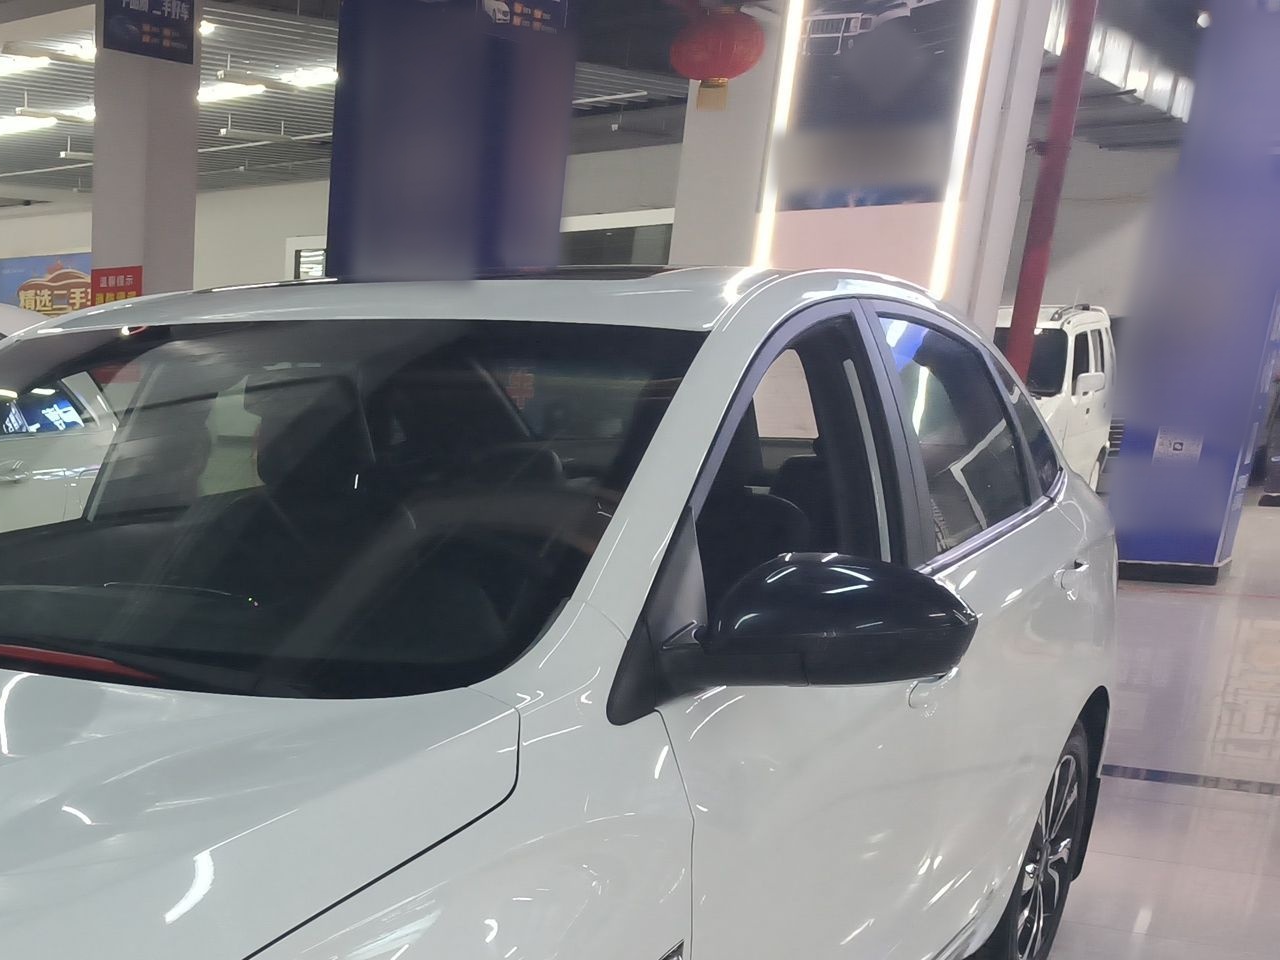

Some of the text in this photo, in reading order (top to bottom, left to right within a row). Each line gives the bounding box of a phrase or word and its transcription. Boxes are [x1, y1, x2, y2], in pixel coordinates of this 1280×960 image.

[99, 274, 134, 288] 温馨提示
[19, 287, 91, 312] 精选二手
